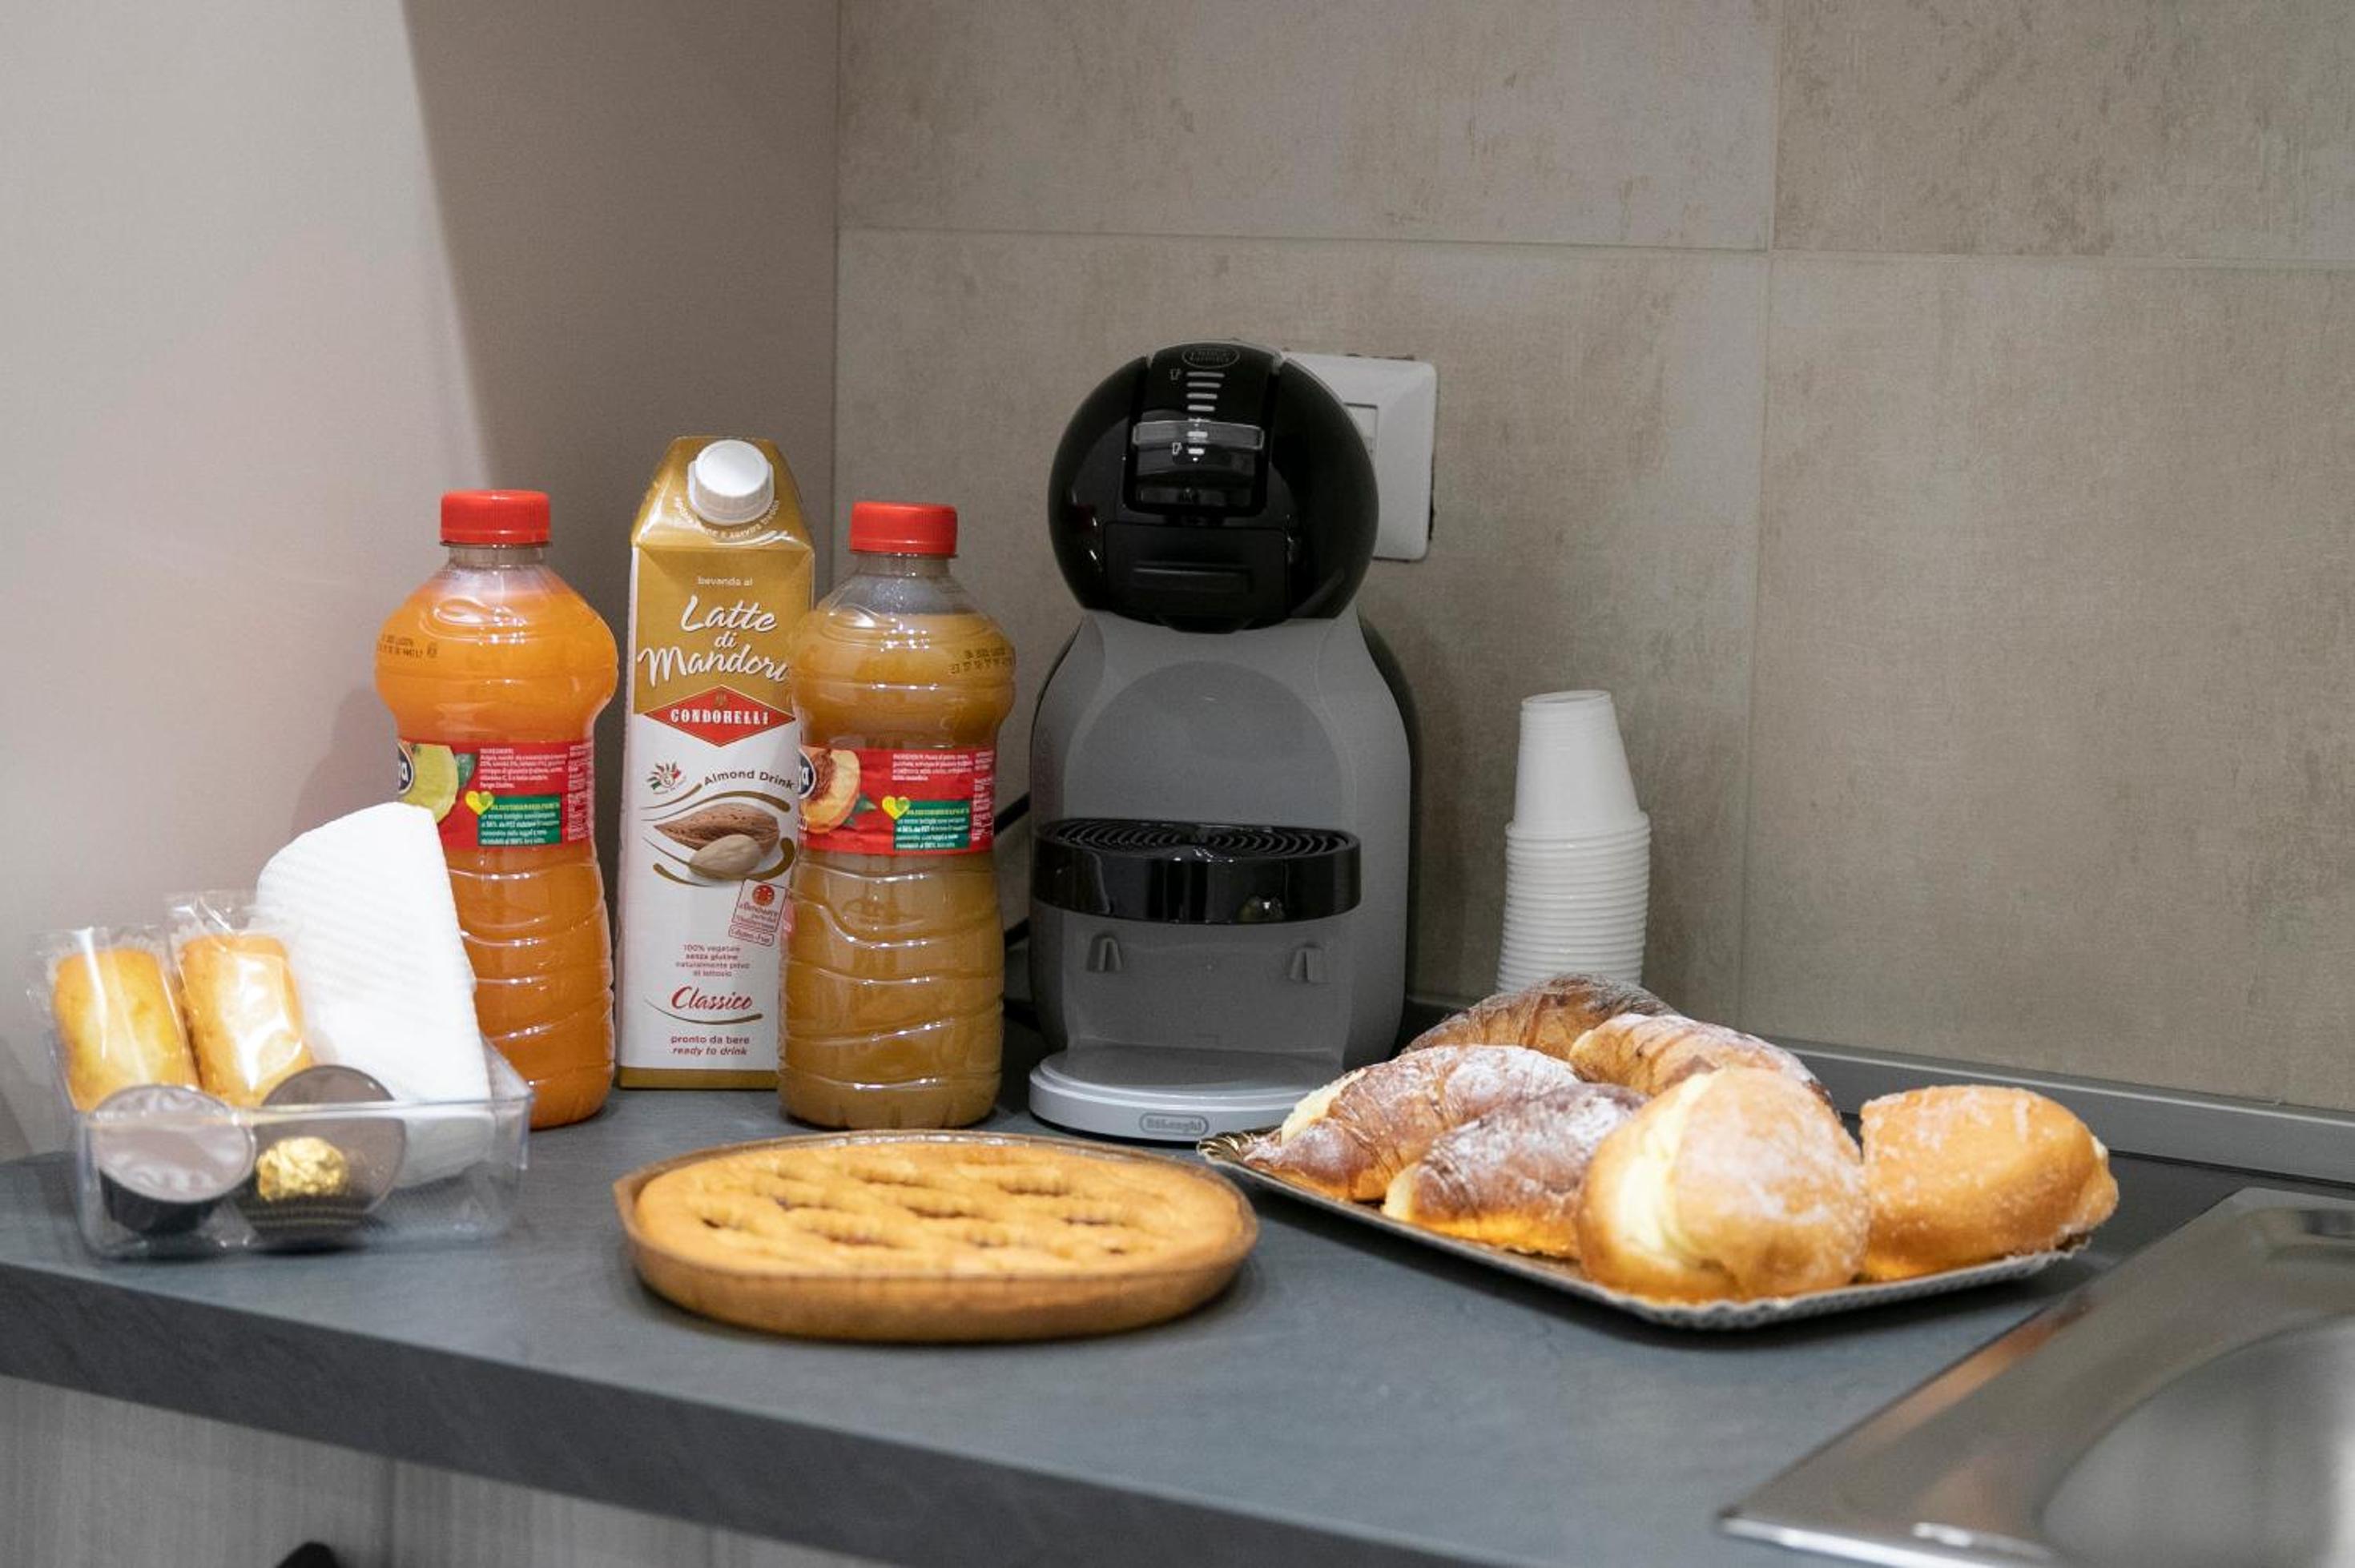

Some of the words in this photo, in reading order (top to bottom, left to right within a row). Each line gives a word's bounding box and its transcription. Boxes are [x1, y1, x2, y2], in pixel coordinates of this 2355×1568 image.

[698, 577, 741, 586] bevanda
[743, 577, 753, 586] al
[681, 594, 778, 632] Latte
[714, 631, 738, 648] di
[638, 644, 788, 687] Mandorl
[670, 709, 769, 726] CONDORELLI
[704, 770, 755, 786] Almond
[759, 771, 795, 790] Drink
[671, 986, 752, 1010] Classico
[671, 1036, 706, 1044] pronto
[710, 1035, 723, 1043] da
[726, 1035, 750, 1044] bere
[673, 1047, 703, 1056] ready
[706, 1047, 717, 1055] to
[720, 1047, 747, 1055] drink
